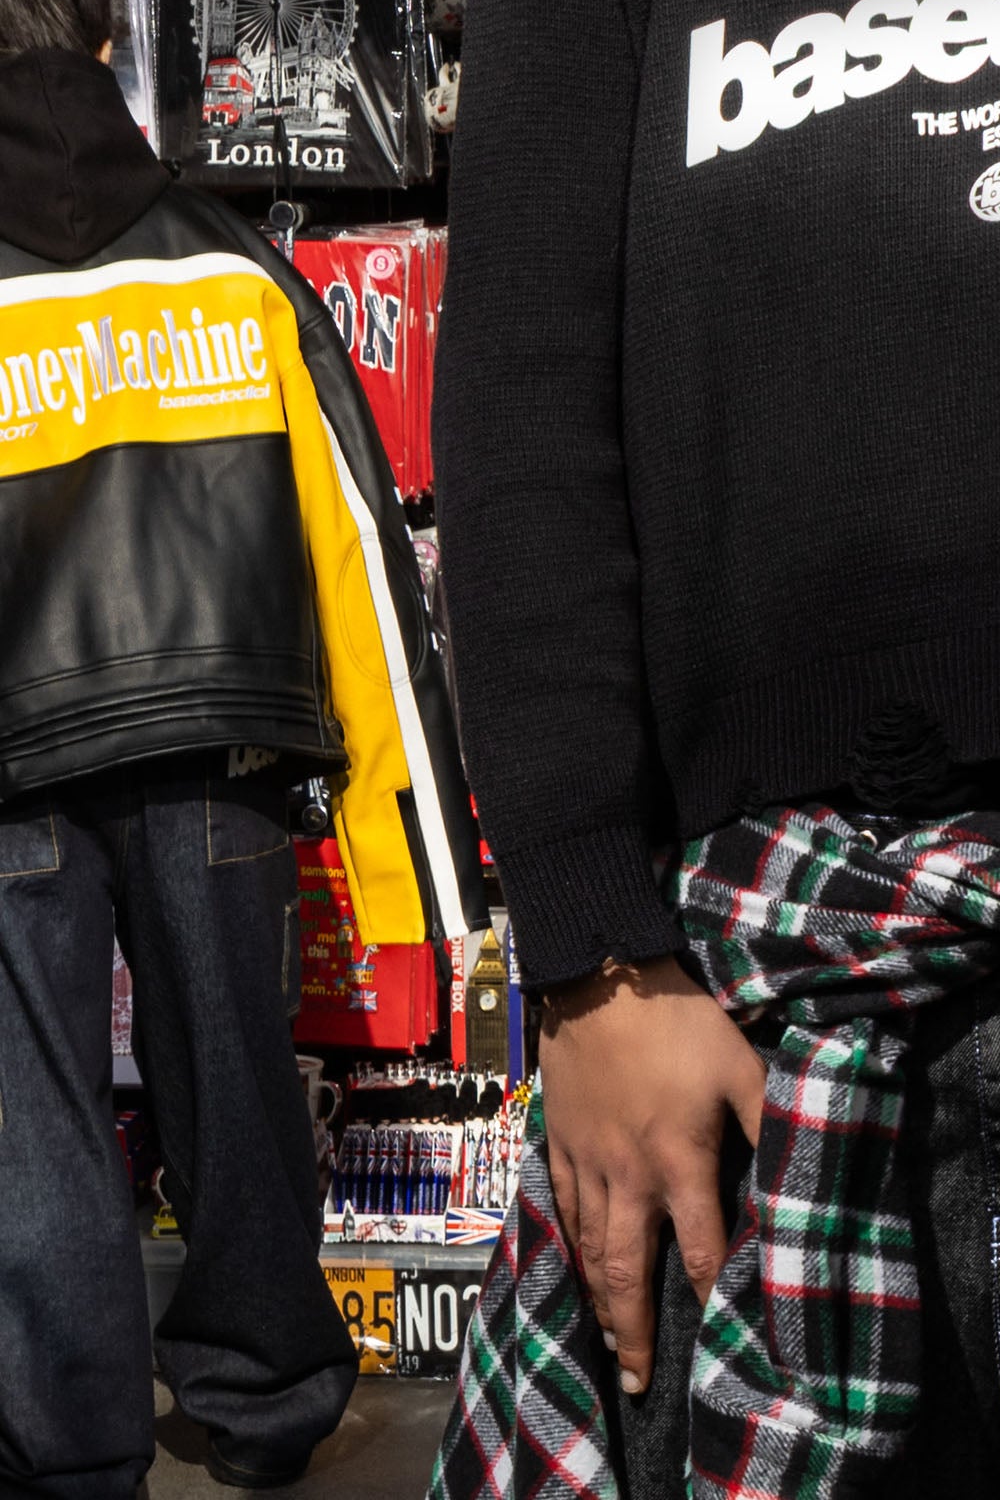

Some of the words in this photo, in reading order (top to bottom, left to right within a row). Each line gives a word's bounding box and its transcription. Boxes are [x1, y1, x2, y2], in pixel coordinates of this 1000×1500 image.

[911, 112, 958, 136] THE
[207, 137, 346, 167] London
[452, 980, 465, 1012] BOX
